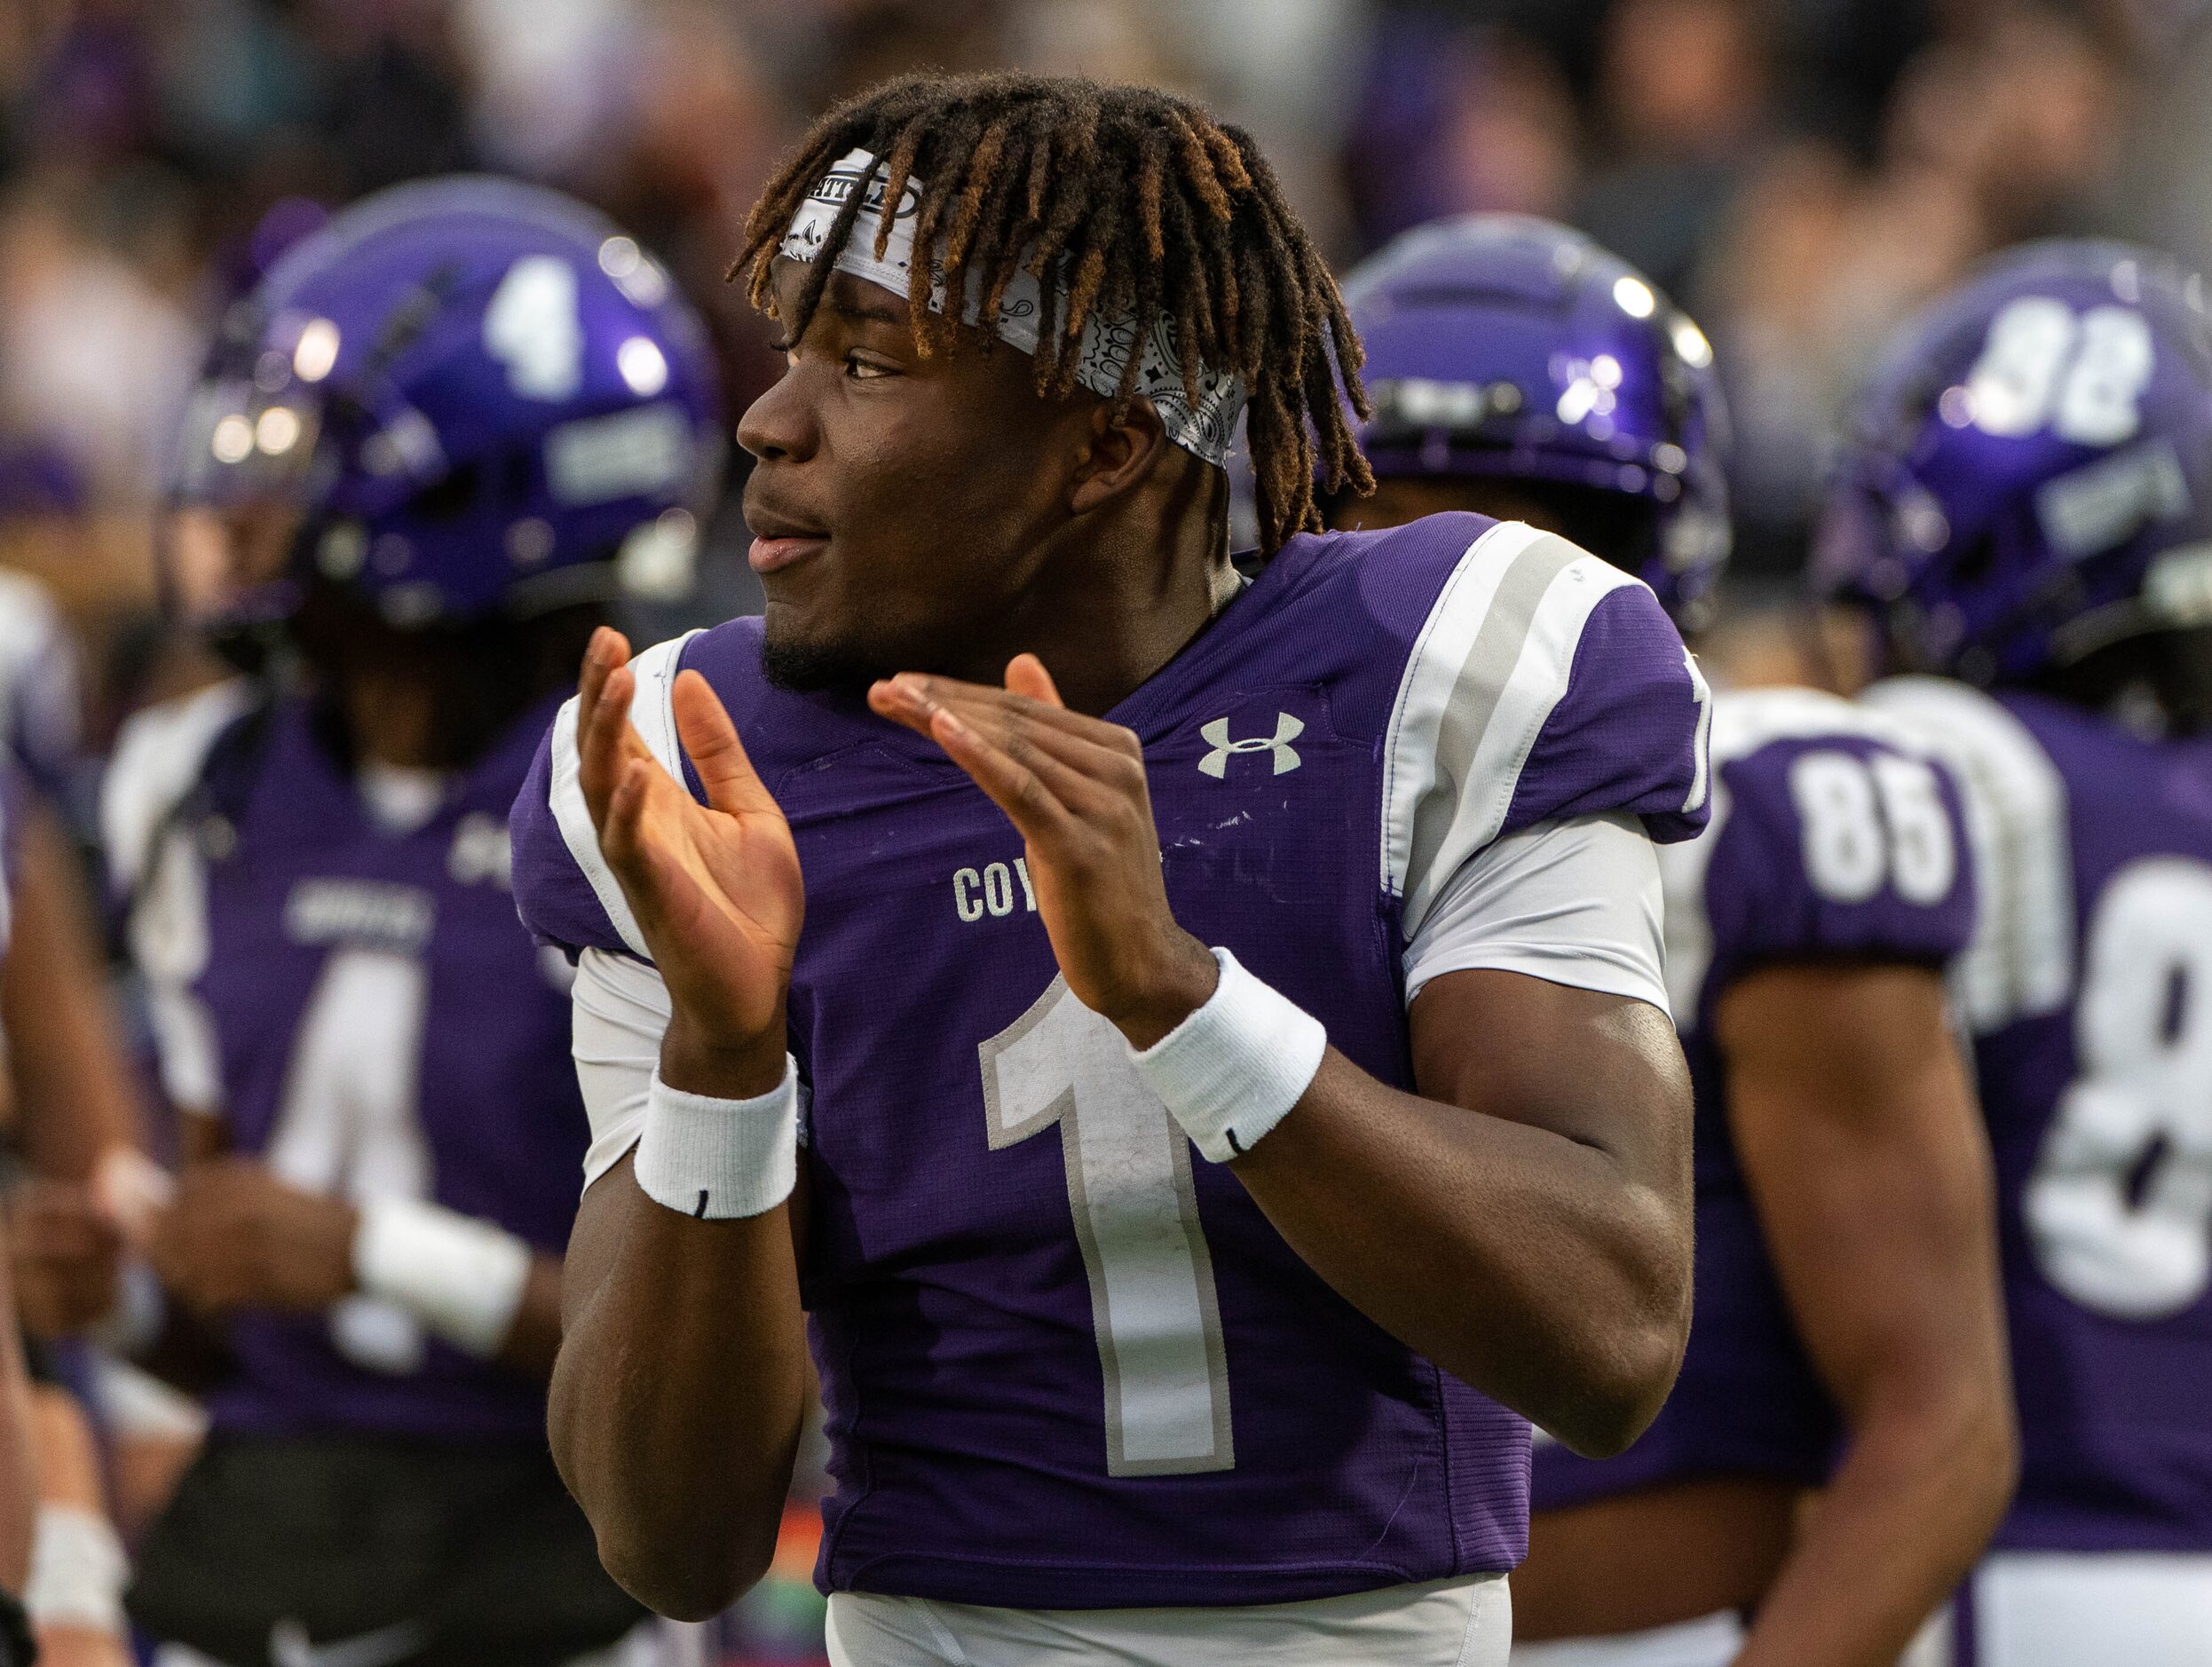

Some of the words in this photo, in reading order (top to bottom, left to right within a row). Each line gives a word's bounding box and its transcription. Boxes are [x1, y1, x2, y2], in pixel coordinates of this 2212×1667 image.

[953, 857, 1037, 922] CO
[1788, 750, 1955, 905] 85
[978, 970, 1235, 1477] 1
